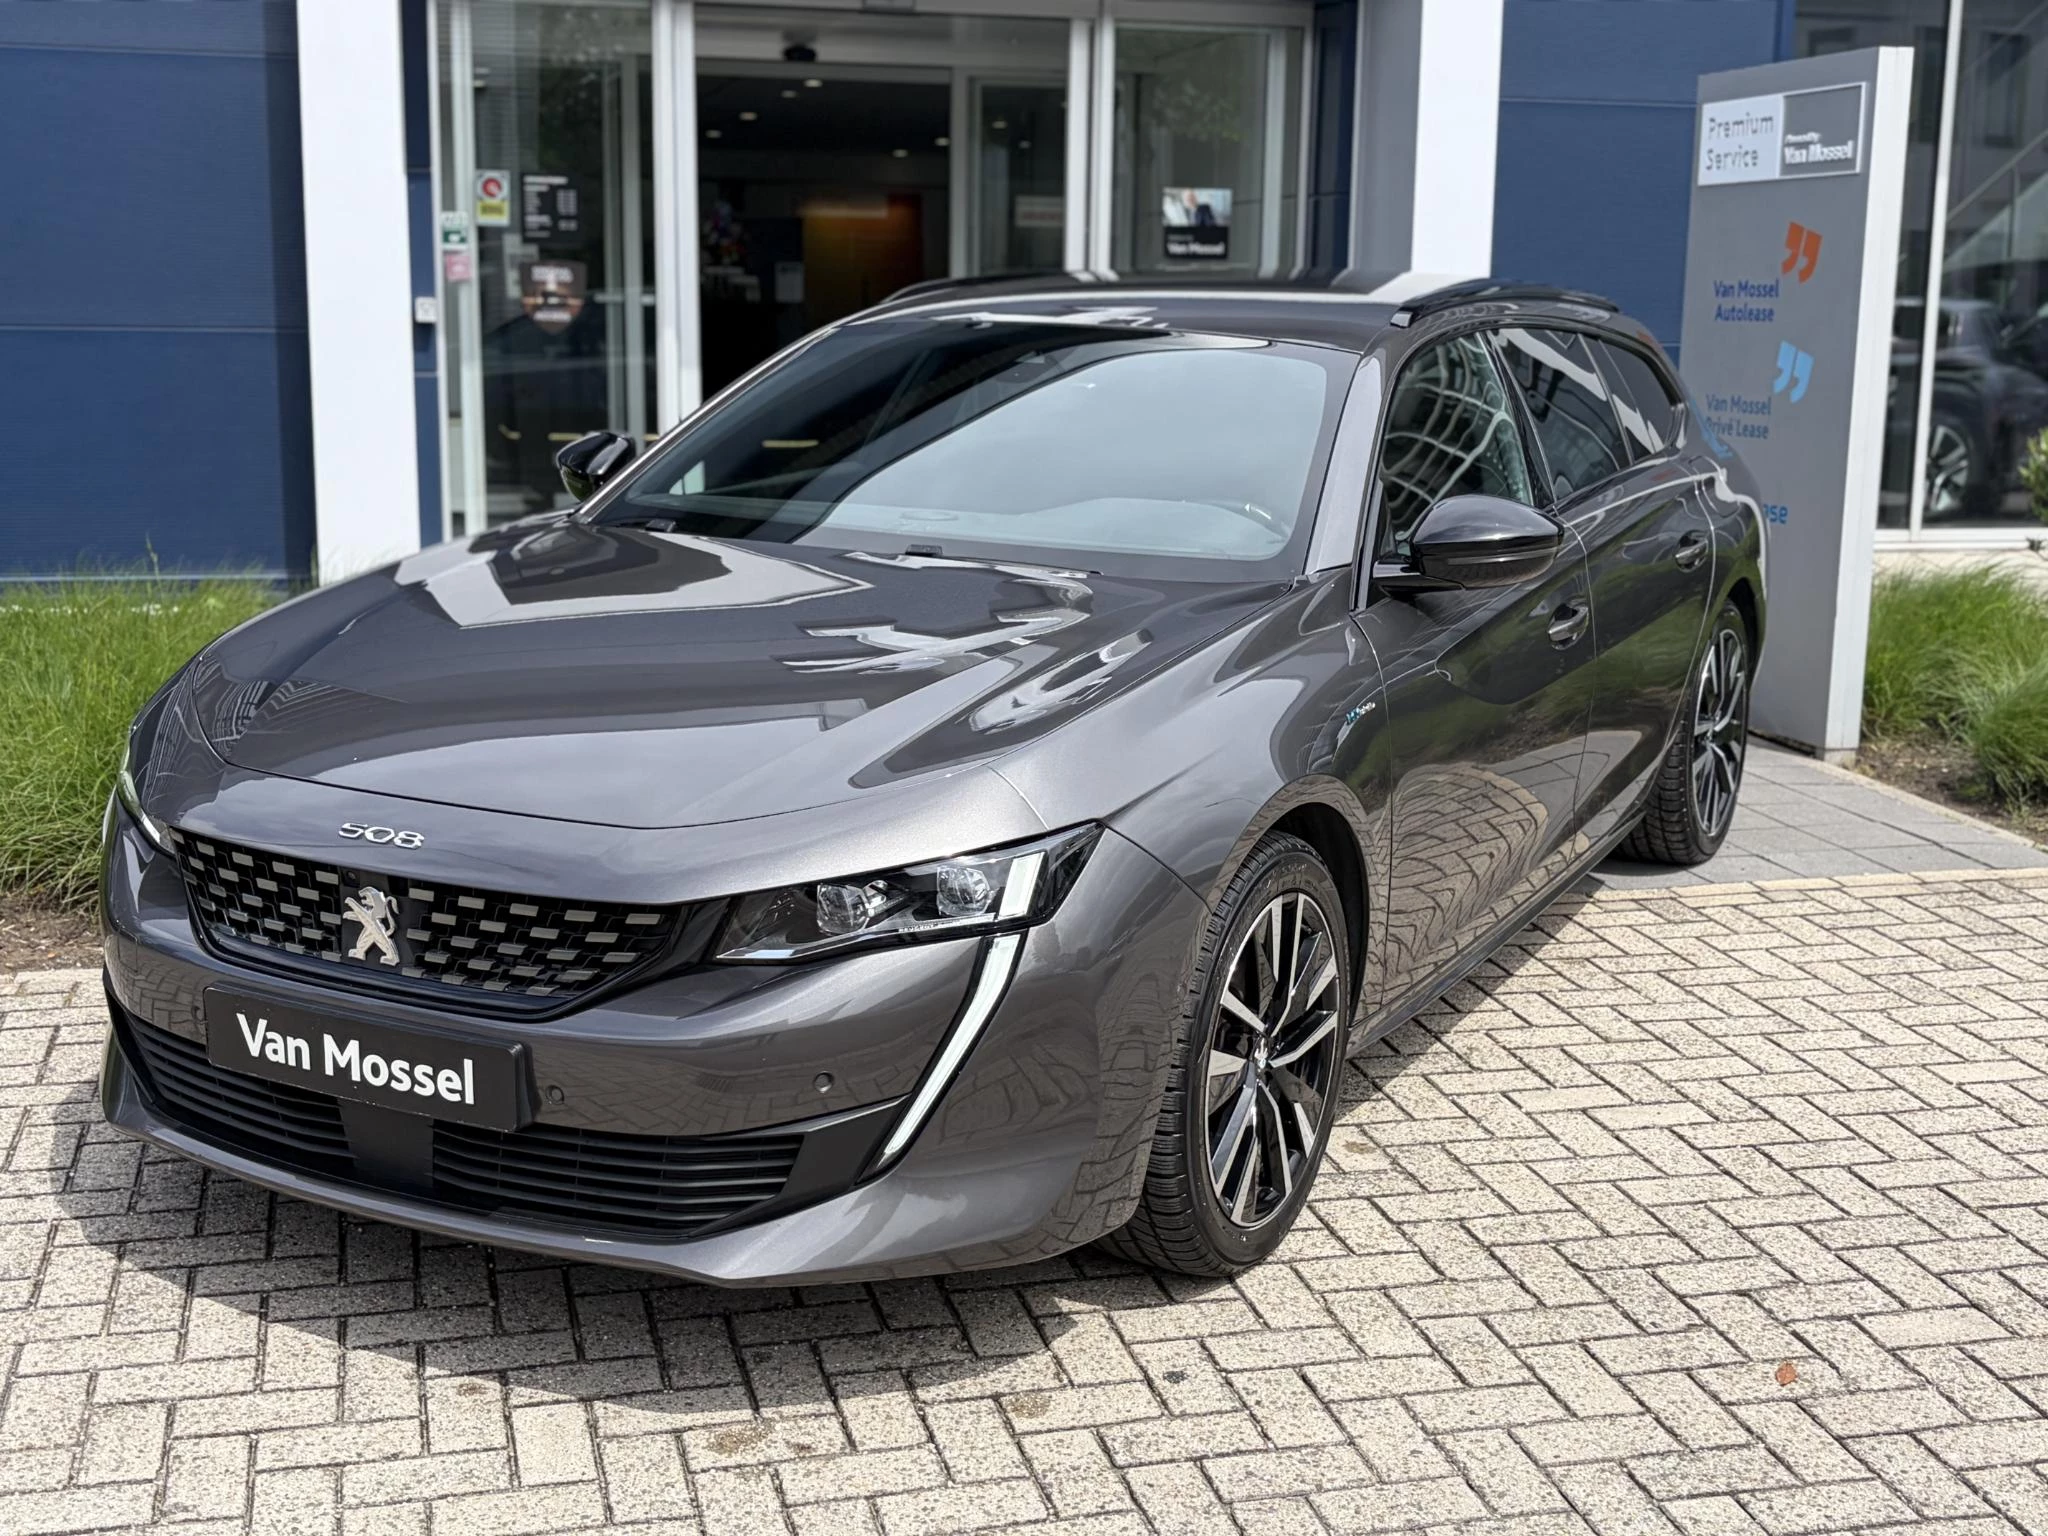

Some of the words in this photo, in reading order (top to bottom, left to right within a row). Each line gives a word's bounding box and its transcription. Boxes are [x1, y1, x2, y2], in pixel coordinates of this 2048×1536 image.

[1708, 112, 1774, 139] Premium
[1706, 145, 1758, 171] Service
[1712, 279, 1735, 298] Van
[1737, 277, 1780, 298] Mossel
[1714, 303, 1775, 322] Autolease
[1705, 393, 1728, 412] Van
[1730, 395, 1772, 416] Mossel
[338, 822, 425, 850] 508
[236, 1013, 311, 1071] Van
[323, 1033, 475, 1105] Mossel
